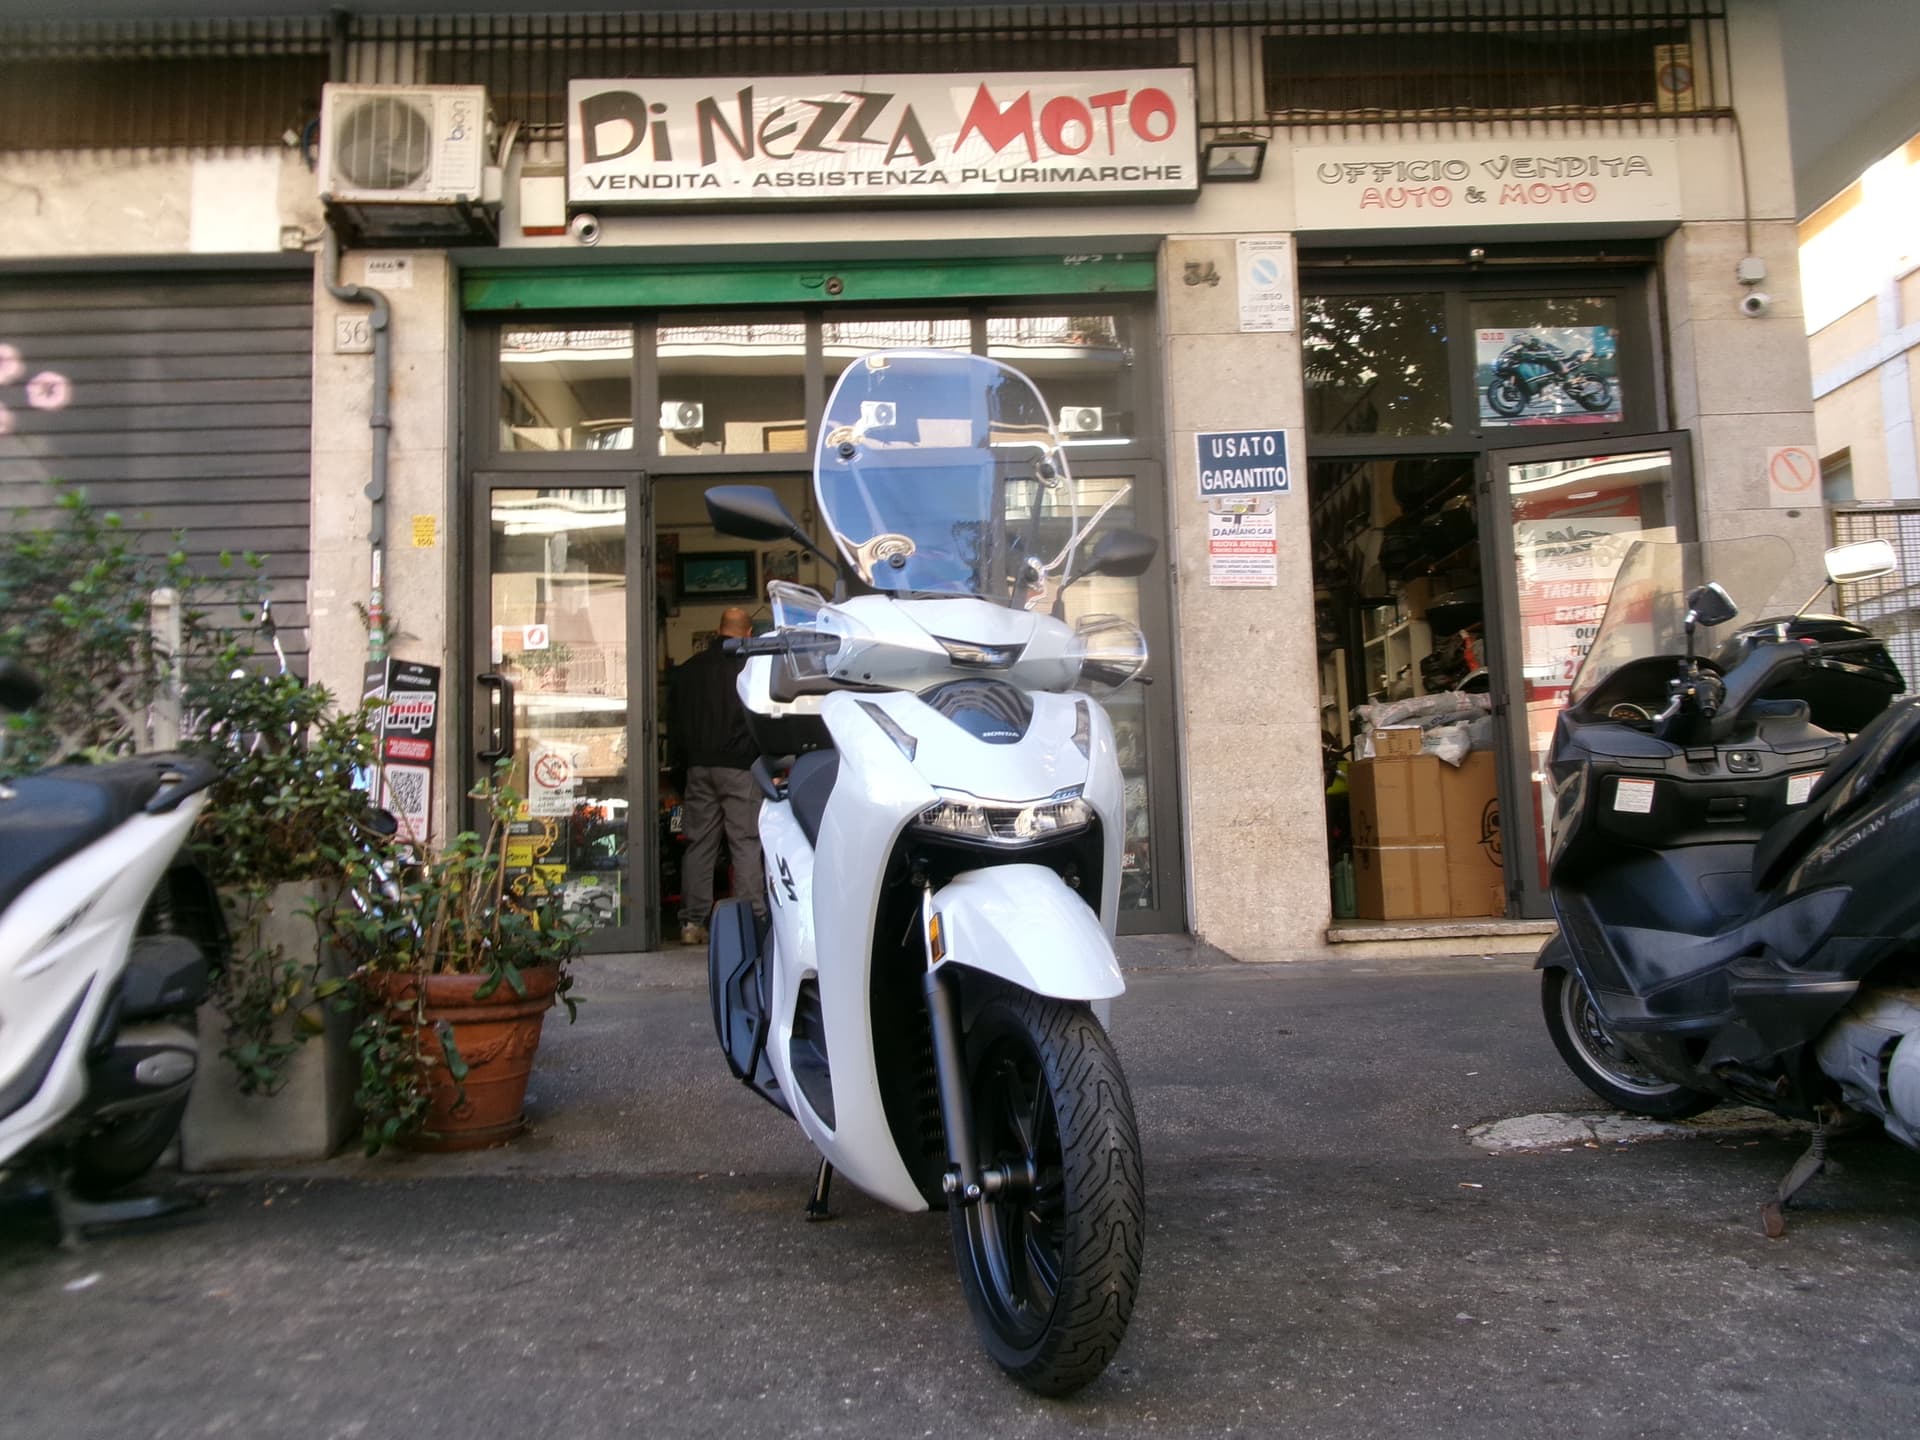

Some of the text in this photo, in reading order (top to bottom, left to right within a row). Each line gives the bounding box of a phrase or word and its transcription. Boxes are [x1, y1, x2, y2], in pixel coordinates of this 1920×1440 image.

[580, 90, 672, 165] Di
[952, 81, 1177, 163] MOTO
[587, 173, 720, 190] VENDITA
[753, 170, 949, 186] ASSISTENZA
[962, 165, 1182, 182] PLURIMARCHE
[1317, 155, 1653, 184] UFFICIO VENDITA
[1360, 182, 1597, 209] AUTO & MOTO
[340, 320, 368, 345] 36
[1212, 436, 1276, 458] USATO
[1202, 467, 1287, 490] GARANTITO
[1212, 527, 1256, 537] DAMIANO
[388, 713, 430, 730] days
